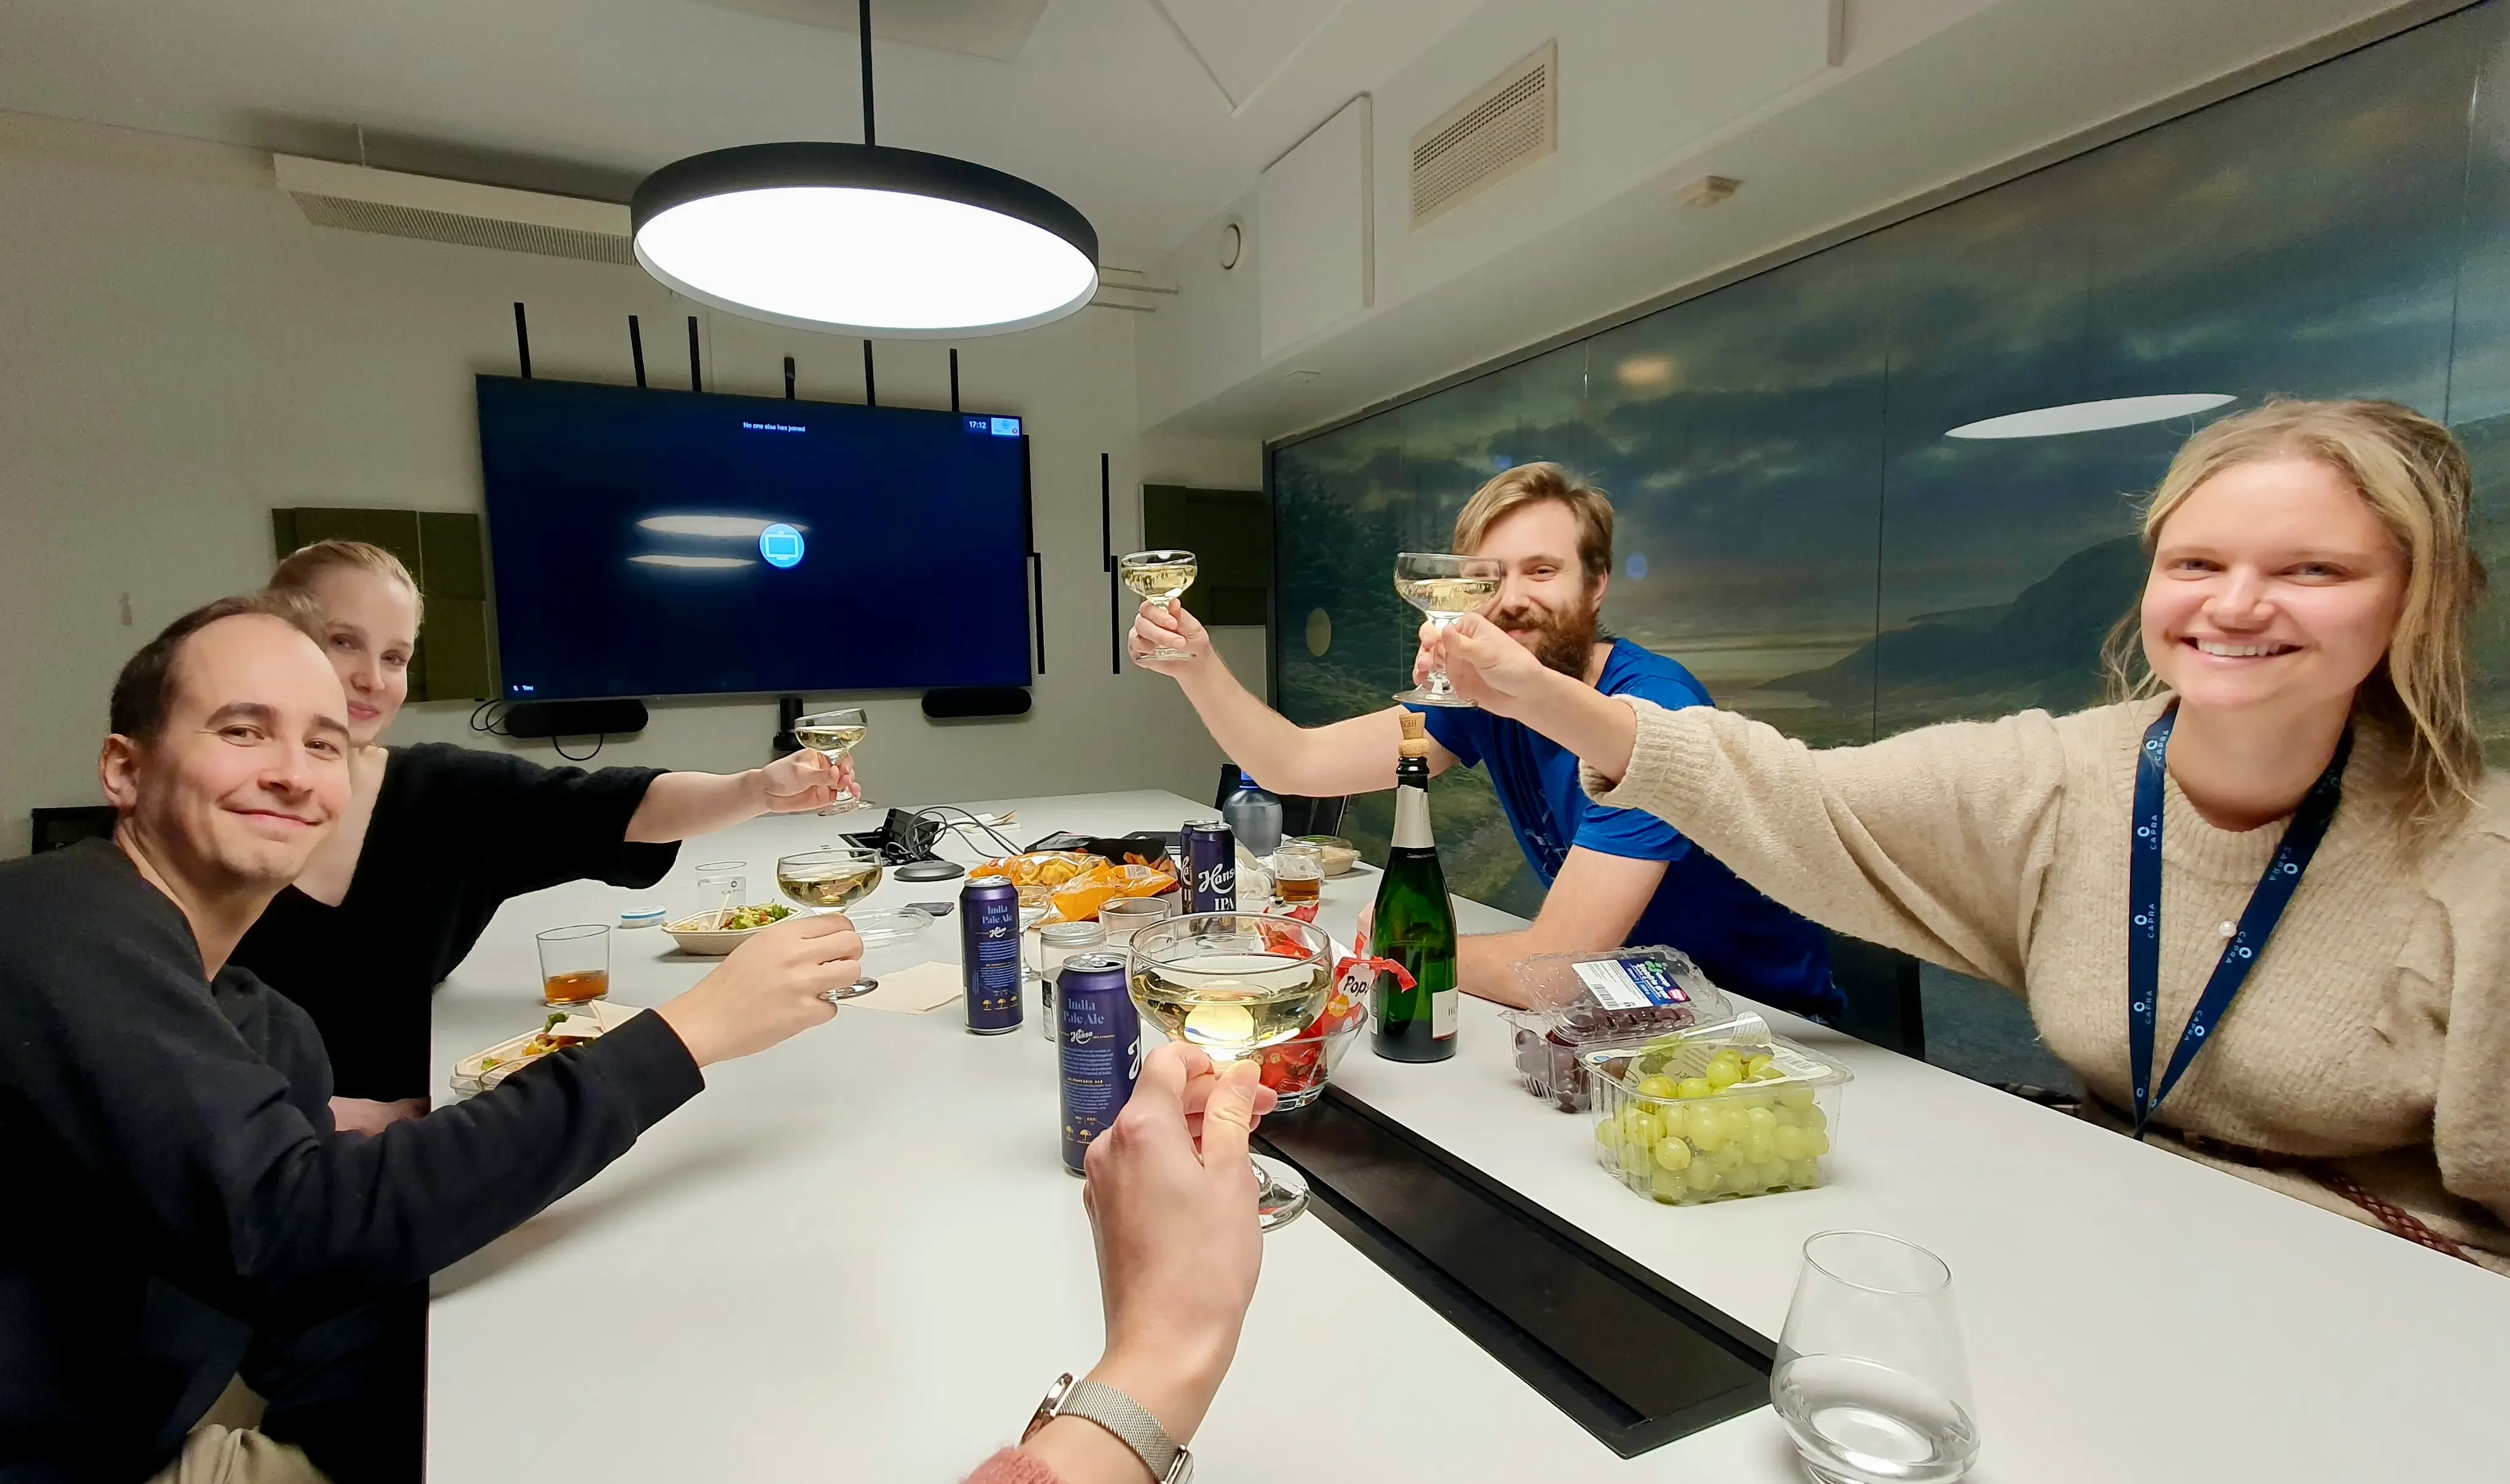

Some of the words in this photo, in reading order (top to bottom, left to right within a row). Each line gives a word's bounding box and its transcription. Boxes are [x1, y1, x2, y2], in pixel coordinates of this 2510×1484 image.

[969, 421, 986, 429] 17:12
[2154, 730, 2169, 761] CAPRA
[2268, 847, 2292, 880] CAPRA
[1198, 863, 1235, 894] Hans
[988, 905, 1008, 914] India
[1214, 897, 1234, 911] IPA
[982, 916, 1000, 925] Pale
[1000, 913, 1013, 923] Ale
[2225, 931, 2246, 964] CAPRA
[1069, 998, 1096, 1011] India
[1063, 1010, 1083, 1024] Pale
[1084, 1013, 1105, 1025] Ale
[2184, 1010, 2203, 1041] CAPRA
[1070, 1028, 1093, 1044] Hansa
